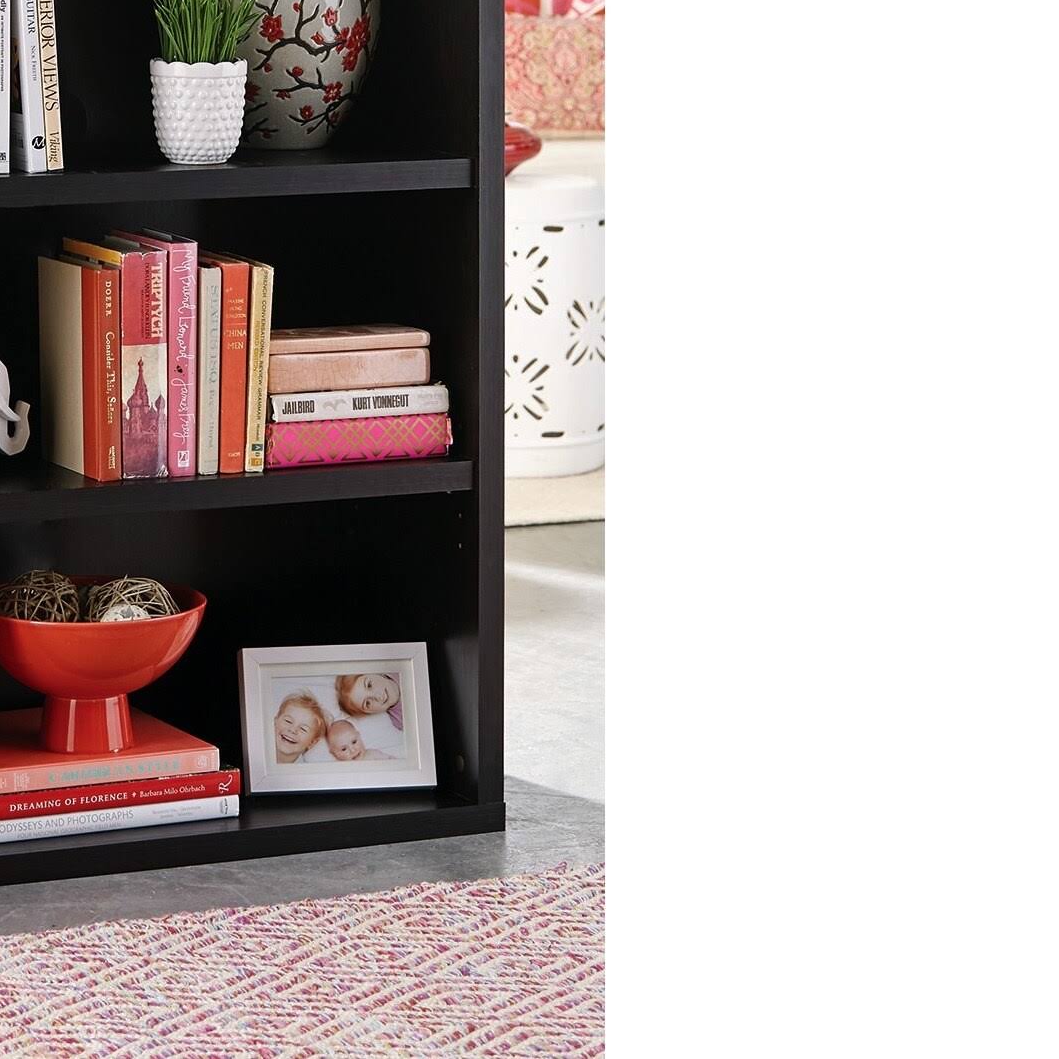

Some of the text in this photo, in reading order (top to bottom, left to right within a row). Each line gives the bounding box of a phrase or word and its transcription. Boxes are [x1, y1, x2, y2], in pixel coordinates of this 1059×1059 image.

[43, 54, 60, 112] VIEWS
[48, 132, 60, 163] Viking
[151, 262, 163, 338] TRIPTYCH
[172, 250, 196, 362] My Friend Leonard
[258, 300, 267, 359] CONVERSATIONAL
[105, 332, 115, 369] Consider
[171, 378, 194, 413] James
[282, 399, 315, 415] JAILBIRD
[352, 396, 371, 411] KURT
[372, 394, 410, 409] VONNEGUT
[172, 414, 195, 445] Frey
[9, 792, 128, 812] DREAMING OF FLORENCE
[140, 789, 162, 798] Barbara
[179, 784, 206, 793] Ohrbach
[44, 817, 65, 828] AND
[67, 809, 135, 826] PHOTOGRAPHS
